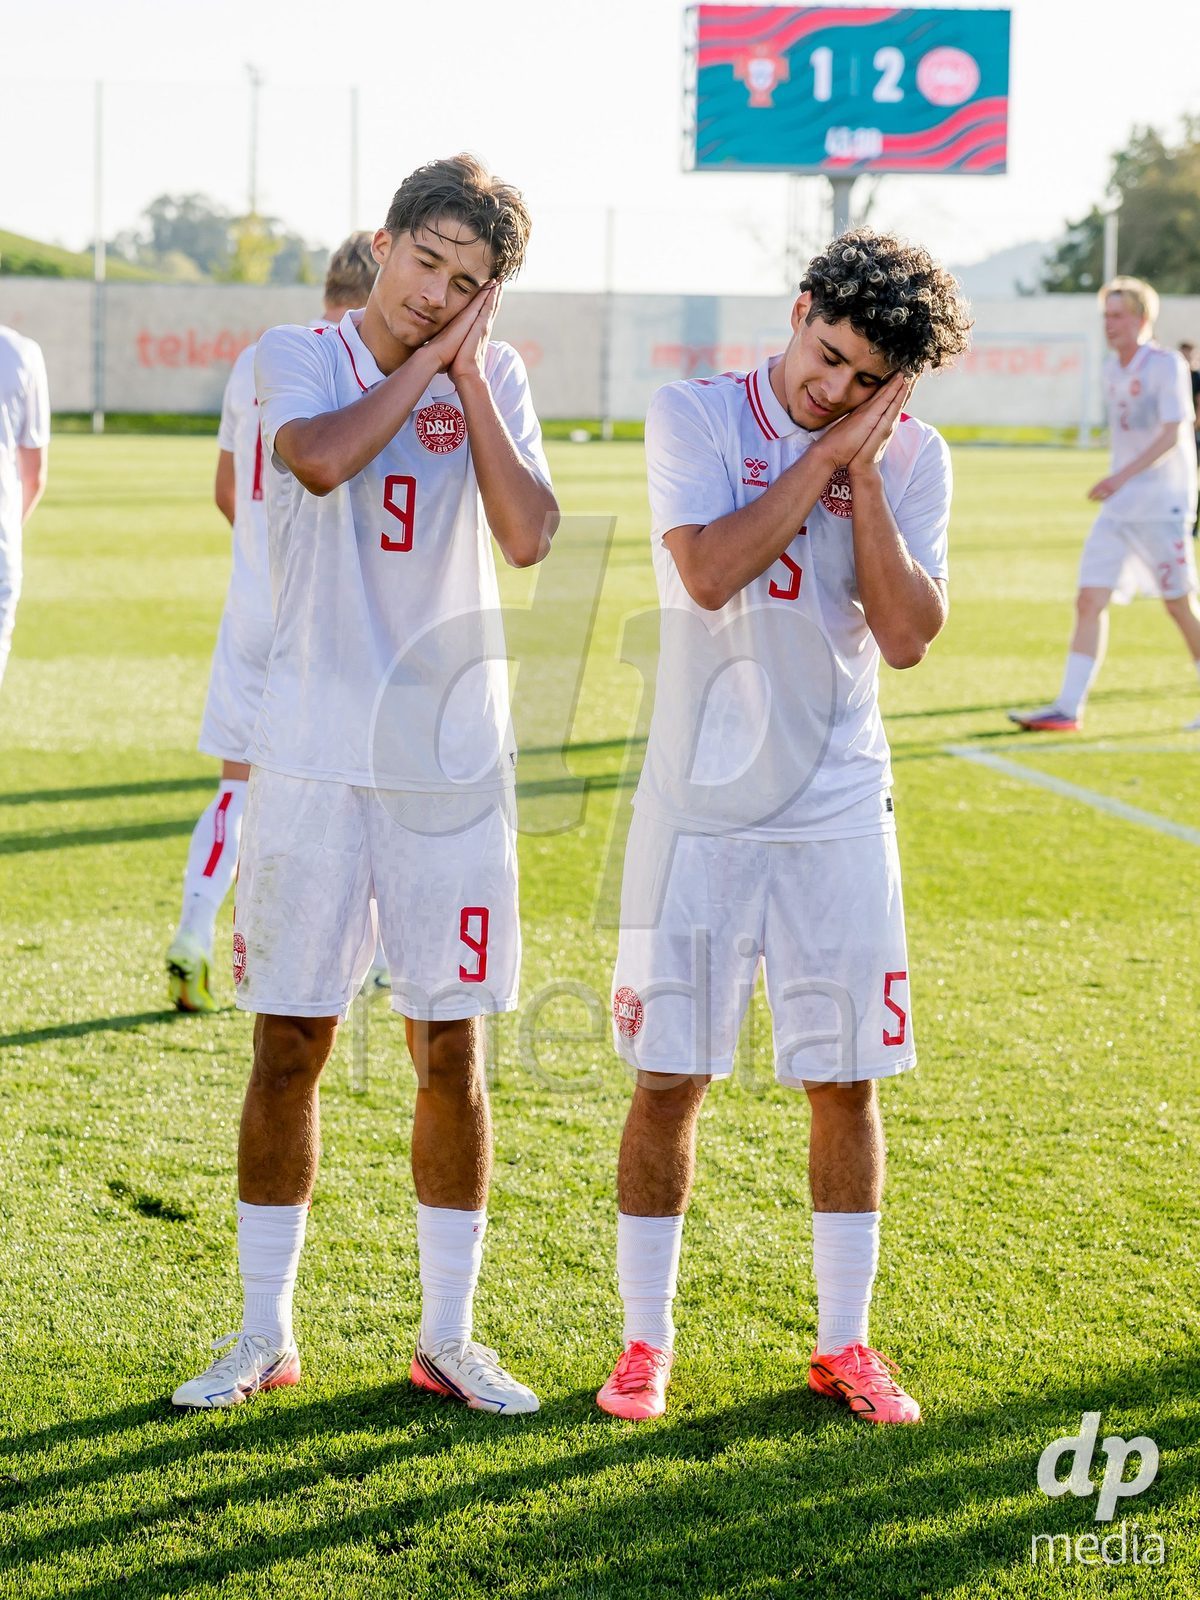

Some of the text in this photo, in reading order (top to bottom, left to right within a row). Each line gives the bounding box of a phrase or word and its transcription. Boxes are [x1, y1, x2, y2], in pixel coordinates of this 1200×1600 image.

[810, 46, 905, 103] 1 2
[425, 419, 456, 435] DBU
[432, 444, 454, 452] 1889
[456, 416, 465, 445] UNION
[380, 474, 417, 553] 9
[830, 484, 853, 501] DB
[459, 906, 490, 984] 9
[882, 971, 907, 1046] 5
